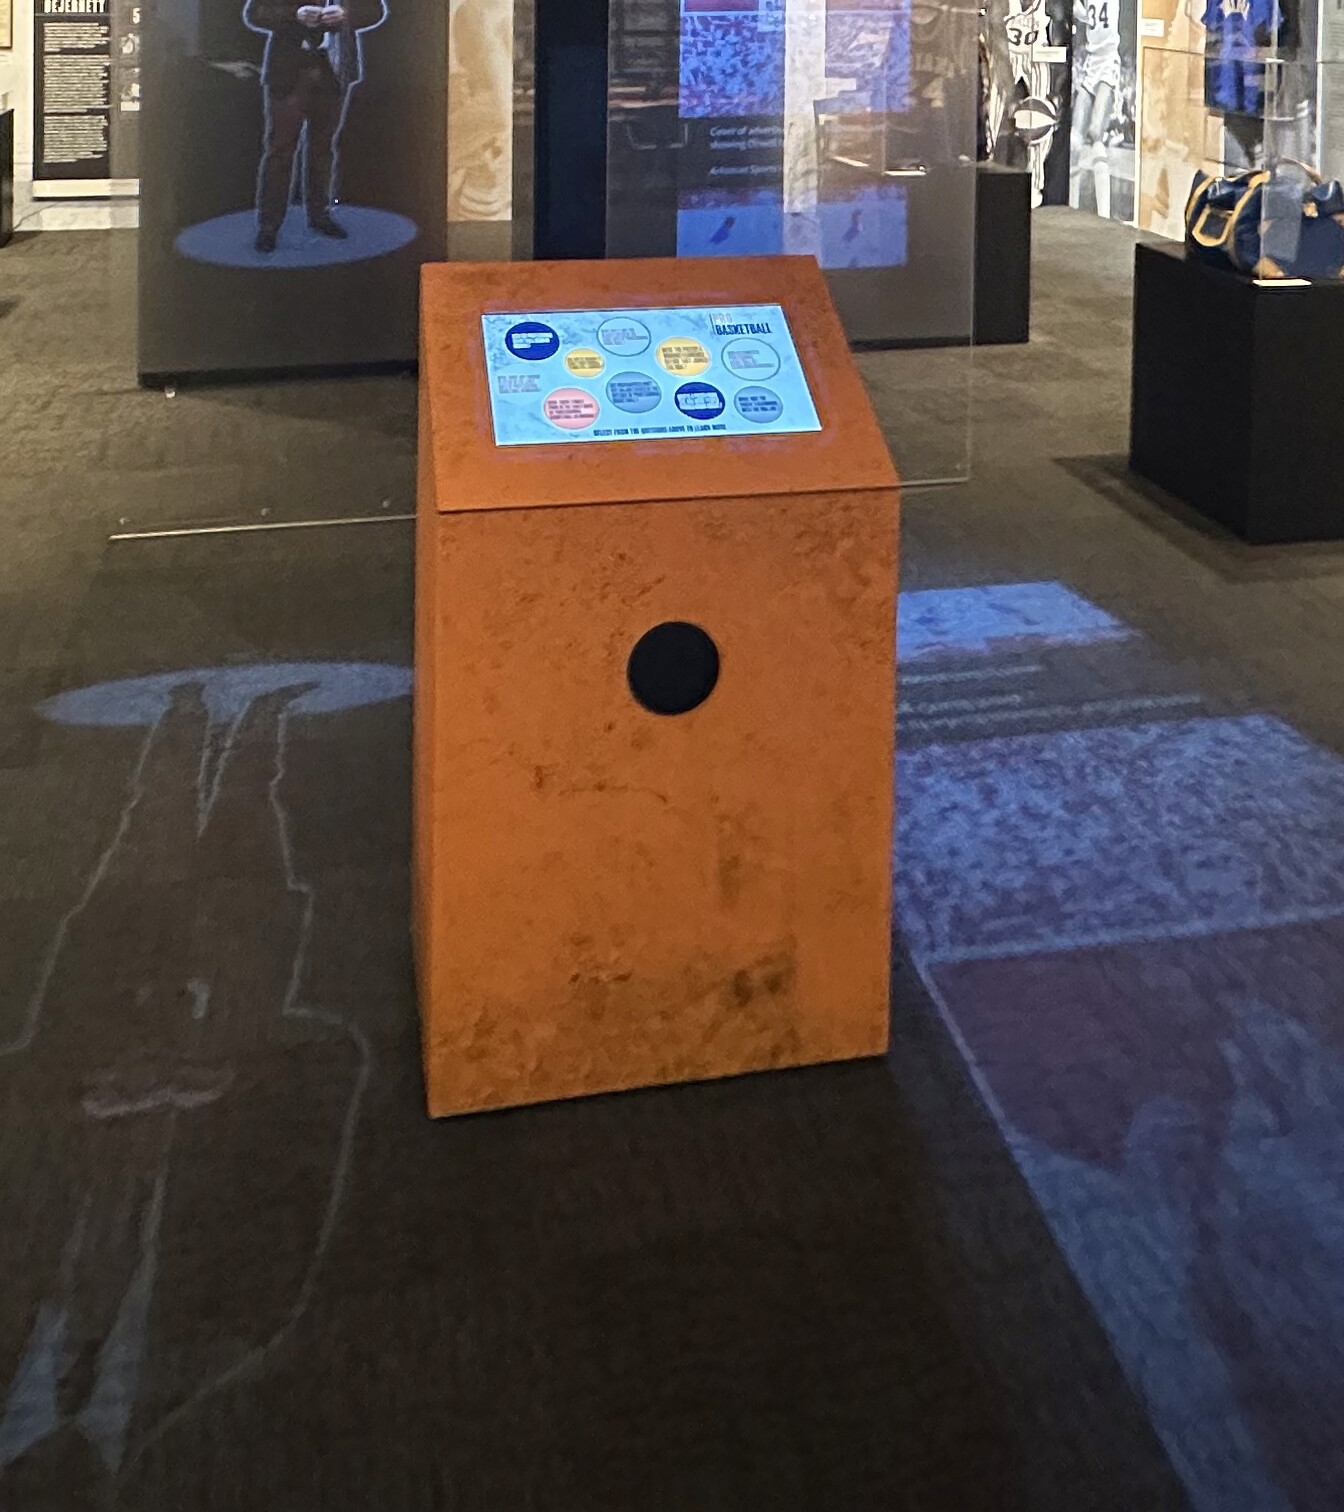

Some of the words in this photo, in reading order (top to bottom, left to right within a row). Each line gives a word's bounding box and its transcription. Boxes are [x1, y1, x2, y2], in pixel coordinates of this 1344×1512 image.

[1089, 3, 1109, 29] 34
[1008, 28, 1038, 46] 30
[712, 313, 732, 323] PRO
[715, 323, 773, 336] BASKETBALL
